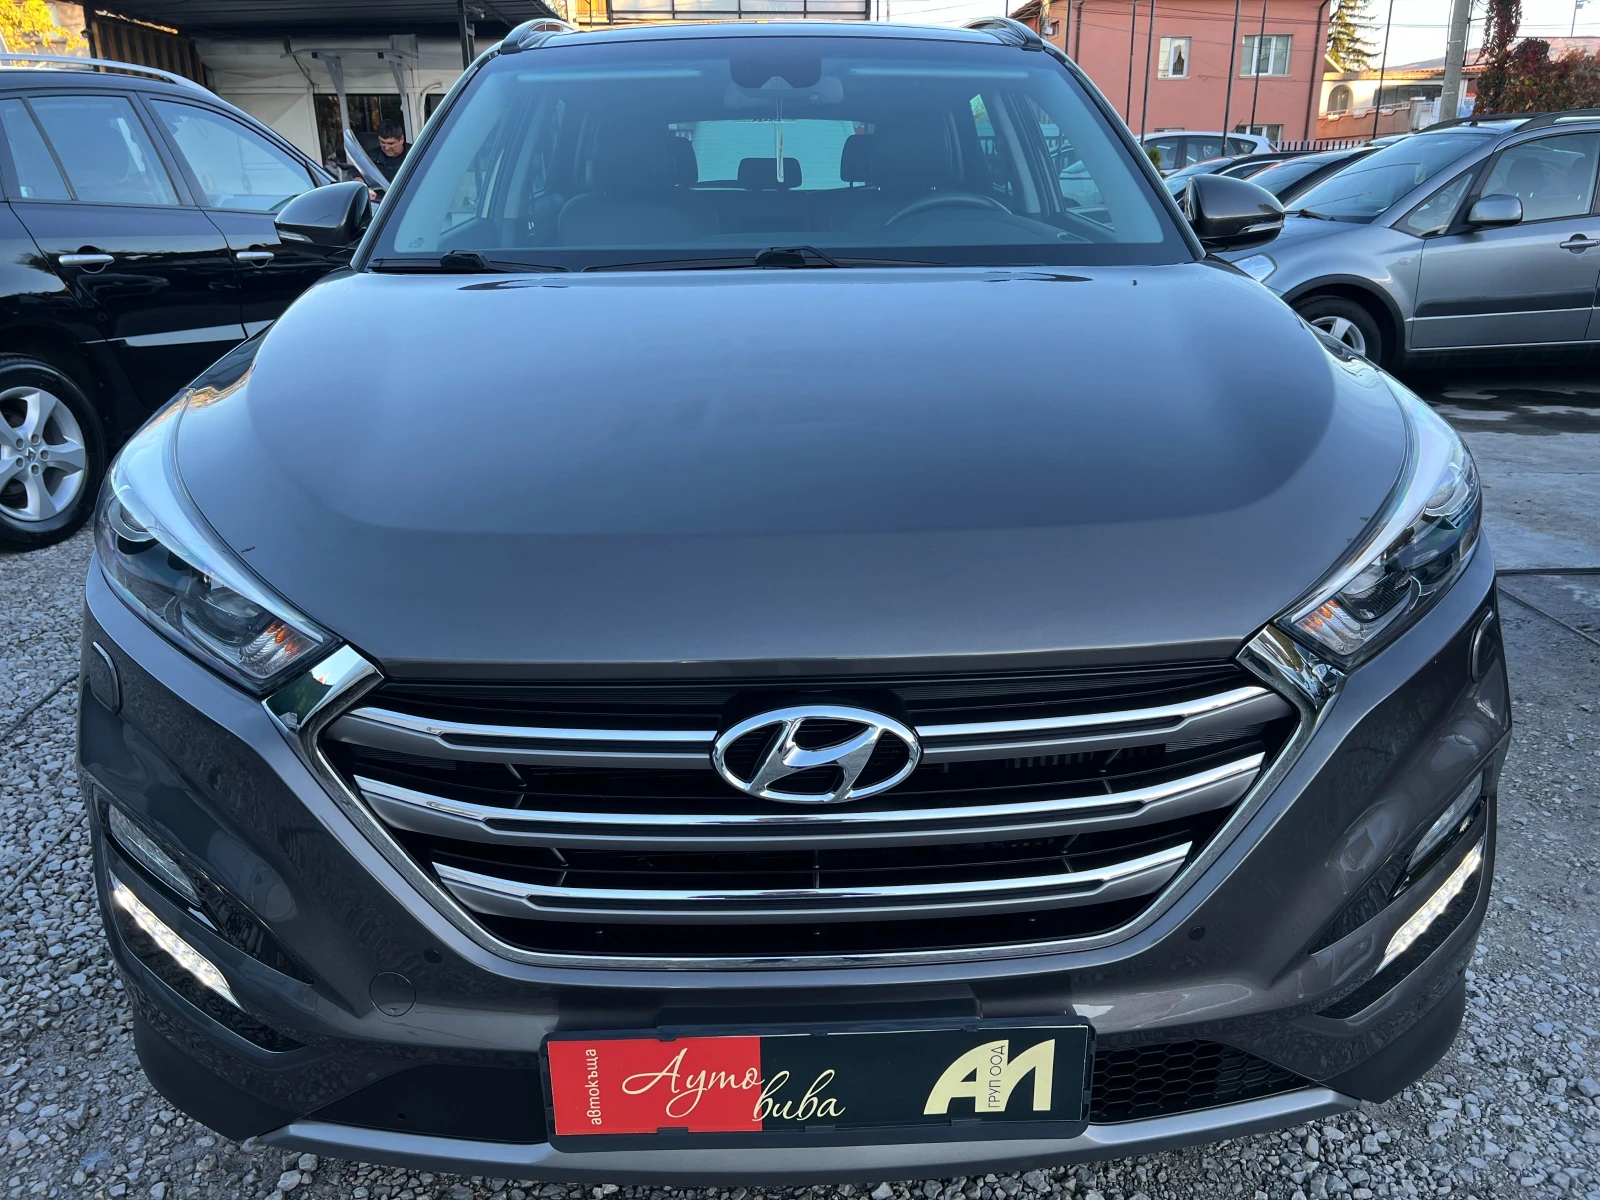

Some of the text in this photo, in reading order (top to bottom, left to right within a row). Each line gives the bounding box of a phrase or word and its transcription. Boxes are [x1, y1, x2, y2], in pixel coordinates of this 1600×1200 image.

[621, 1047, 765, 1118] Ауто
[988, 1045, 1005, 1108] ГРУП ООД
